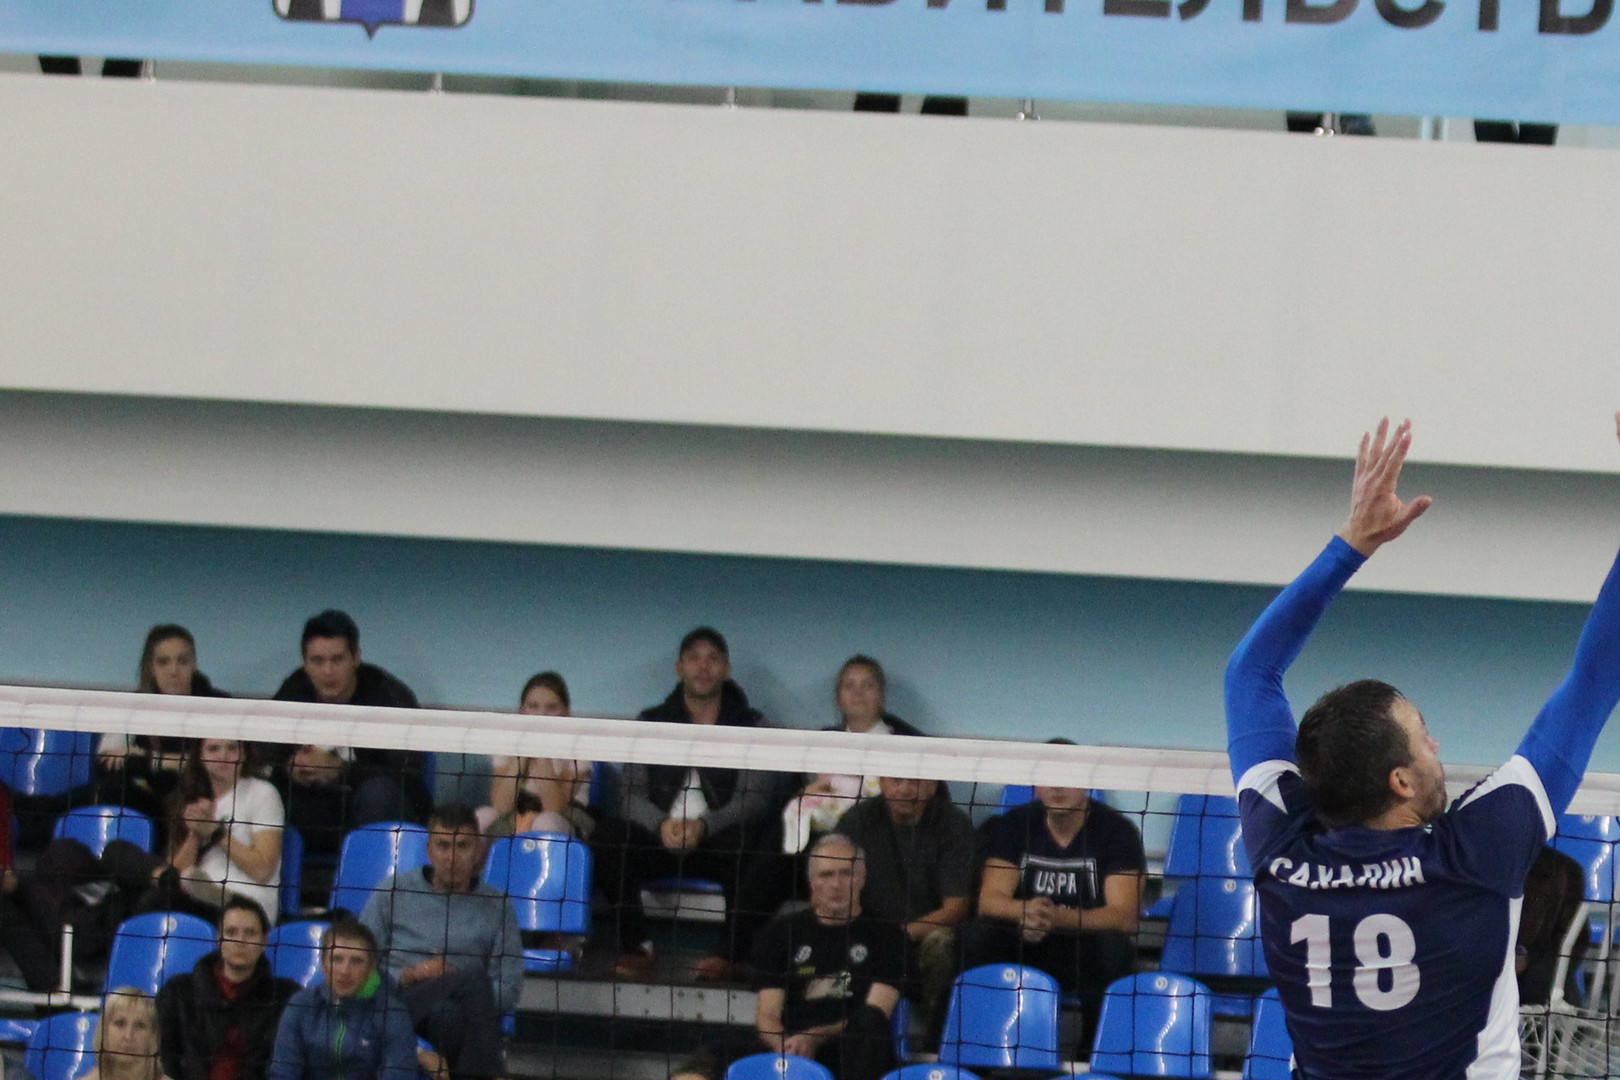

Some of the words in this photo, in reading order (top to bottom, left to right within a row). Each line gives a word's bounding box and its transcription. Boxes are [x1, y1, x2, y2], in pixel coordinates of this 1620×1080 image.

[1035, 870, 1078, 895] USPA
[1269, 856, 1427, 890] САХАЛИН
[1290, 913, 1420, 1012] 18
